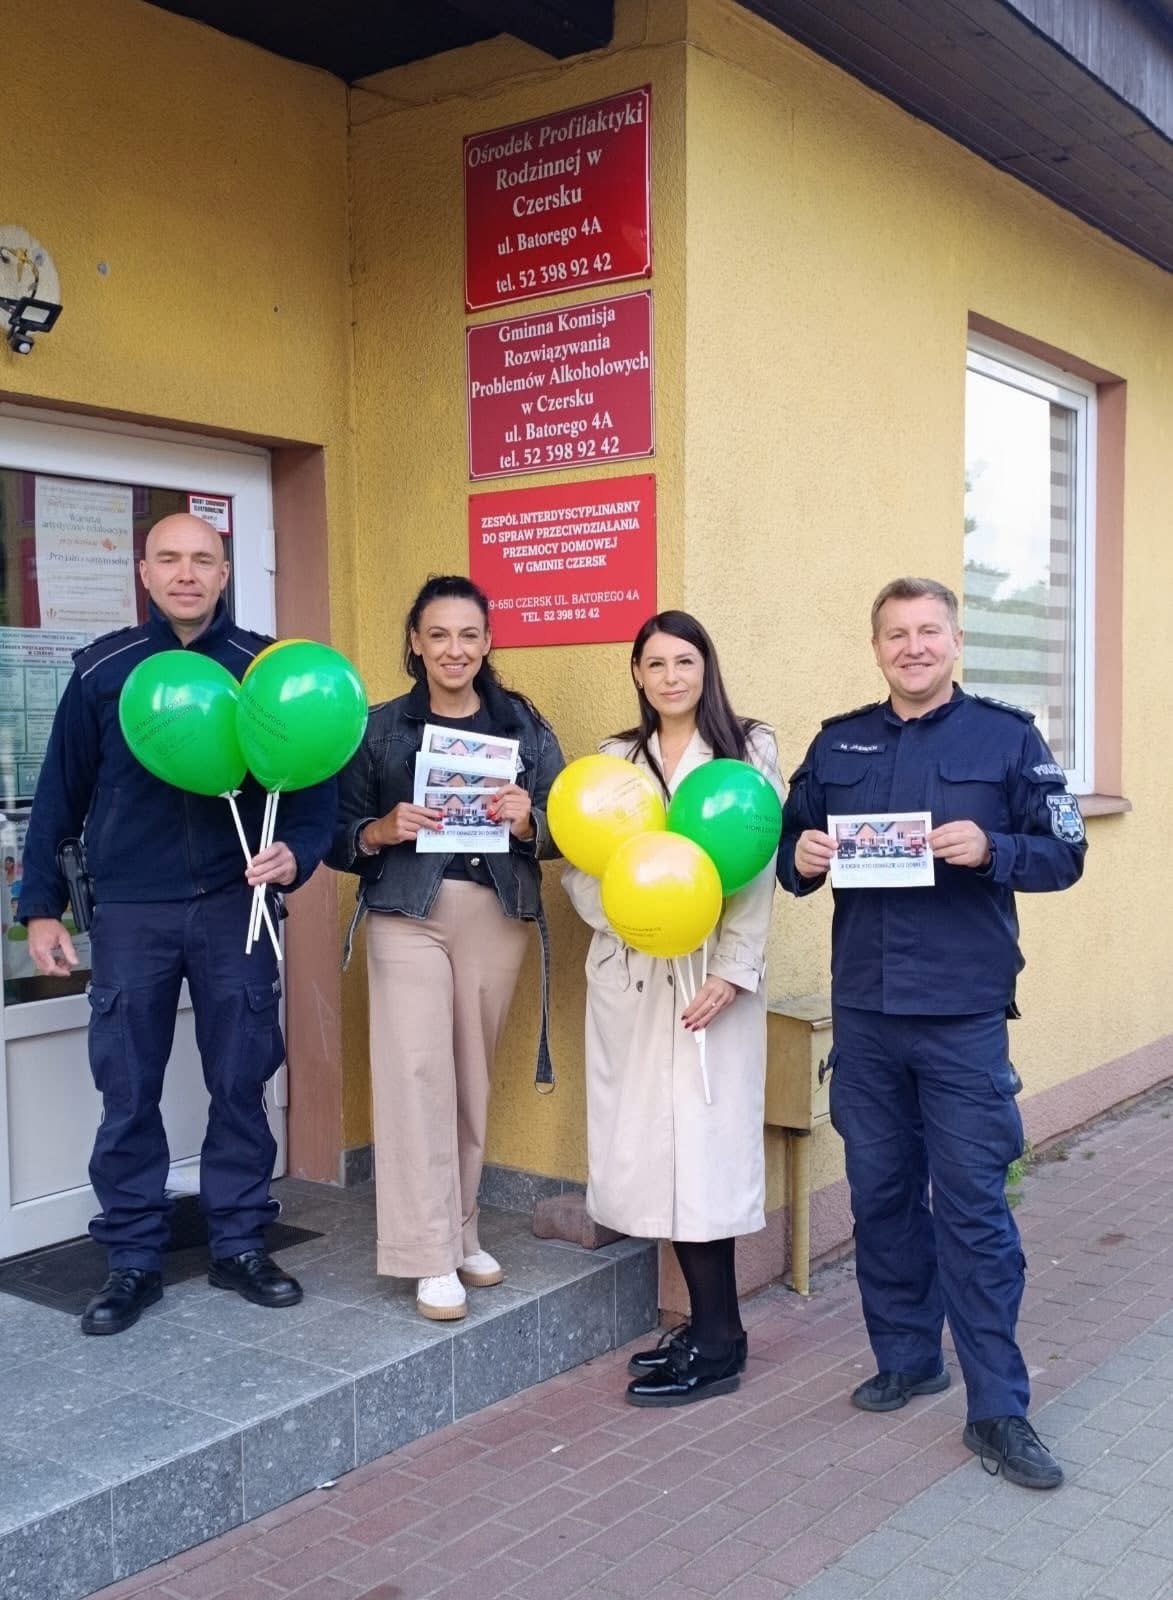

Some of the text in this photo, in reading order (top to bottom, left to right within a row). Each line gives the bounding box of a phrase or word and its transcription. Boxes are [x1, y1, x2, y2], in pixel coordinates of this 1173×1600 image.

[468, 101, 643, 168] Ośrodek Profilaktyki
[495, 148, 602, 190] Rodzinnej w
[512, 184, 582, 217] Czersku
[498, 216, 602, 256] ul. Batorego 4A
[496, 252, 612, 293] tel. 52 398 92 42
[499, 305, 616, 343] Gminna Komisja
[504, 333, 610, 368] Rozwiązywania
[471, 351, 649, 398] Problemów Alkoholowych
[521, 388, 594, 415] w Czersku
[505, 411, 613, 443] ul. Batorego 4A
[500, 436, 620, 469] tel. 52 398 92 42
[481, 500, 641, 529] ZESPÓŁ INTERDYSCYPLINARNY
[482, 517, 640, 544] DO SPRAW PRZECIWDZIAŁANIA
[502, 536, 618, 559] PRZEMOCY DOMOWEJ
[513, 554, 607, 574] W GMINIE CZERSK
[488, 599, 514, 610] 9-650
[516, 595, 552, 608] CZERSK
[571, 590, 624, 605] BATOREGO
[626, 588, 639, 600] 4A
[544, 610, 555, 621] 52
[557, 609, 573, 620] 398
[575, 608, 586, 619] 92
[588, 607, 600, 618] 42
